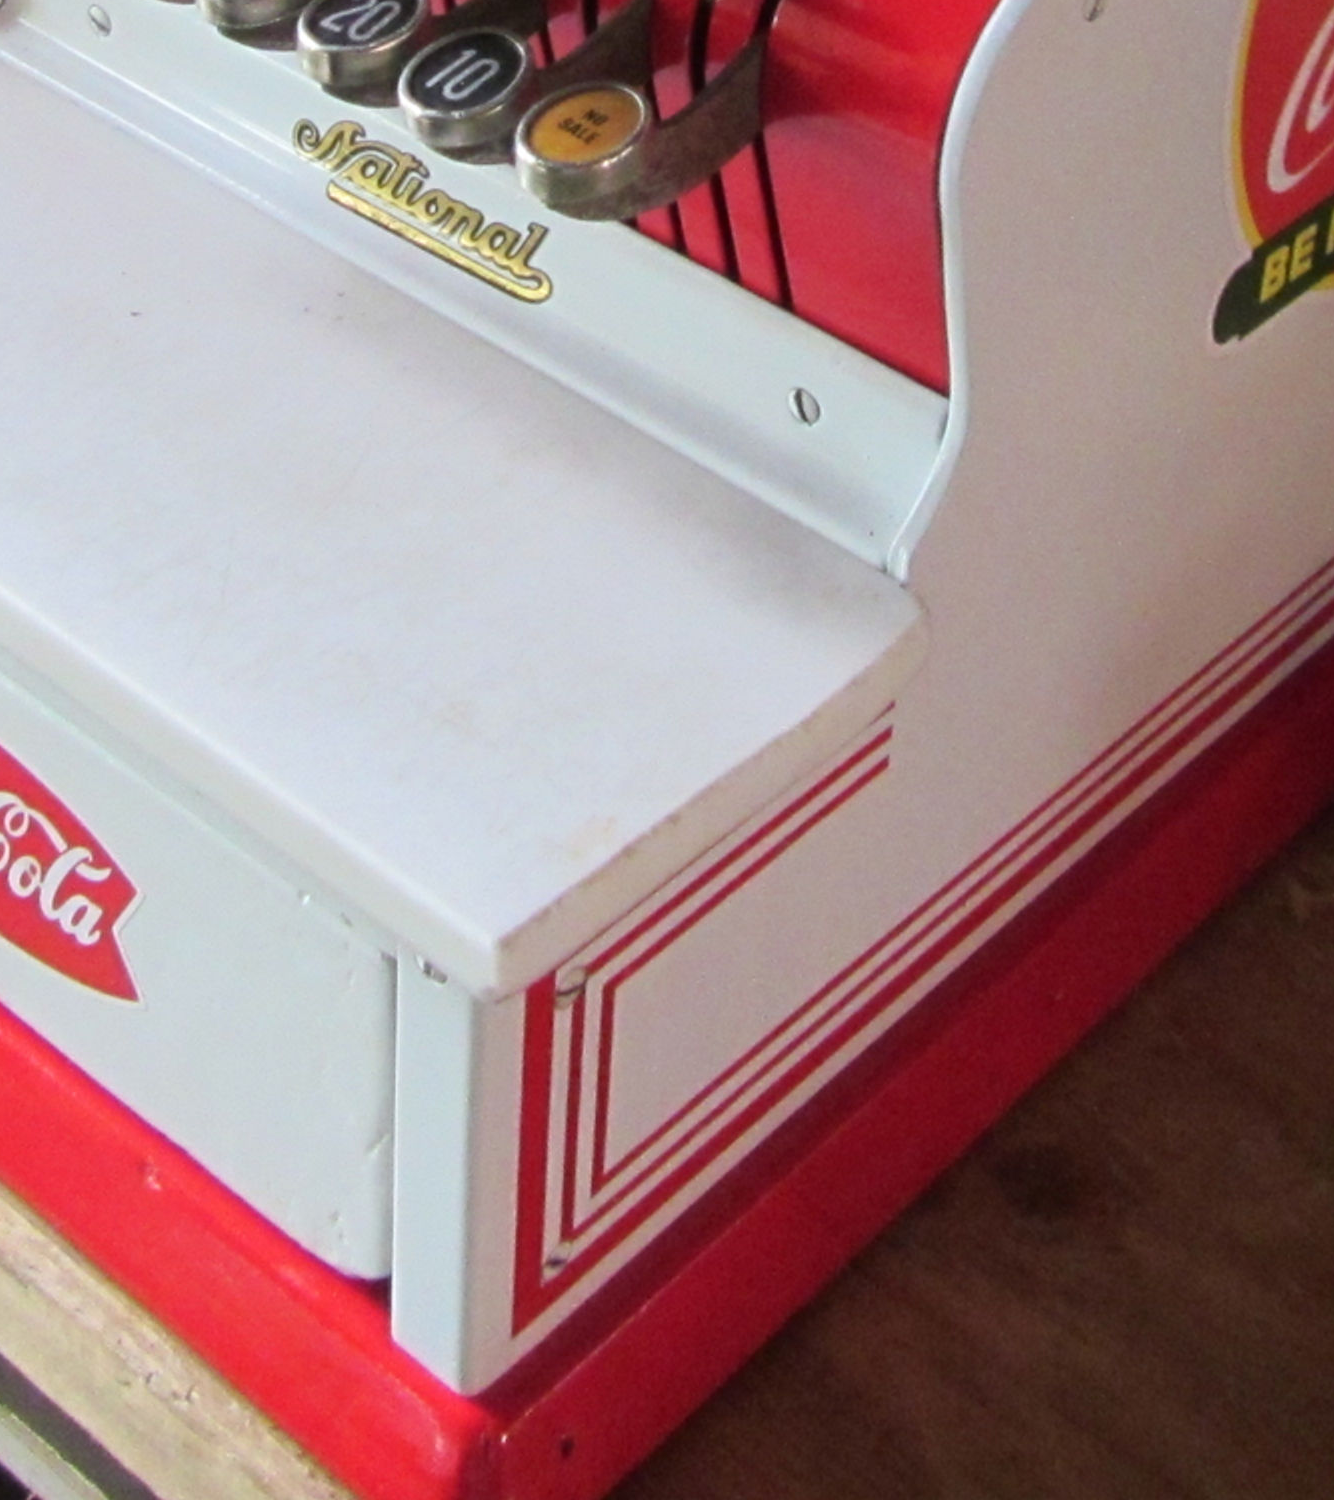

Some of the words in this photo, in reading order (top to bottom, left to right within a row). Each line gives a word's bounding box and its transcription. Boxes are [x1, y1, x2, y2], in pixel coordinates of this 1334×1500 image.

[423, 47, 502, 99] 10
[558, 117, 601, 145] SALE
[583, 109, 609, 127] NO
[292, 116, 553, 304] National
[1260, 223, 1318, 303] BE
